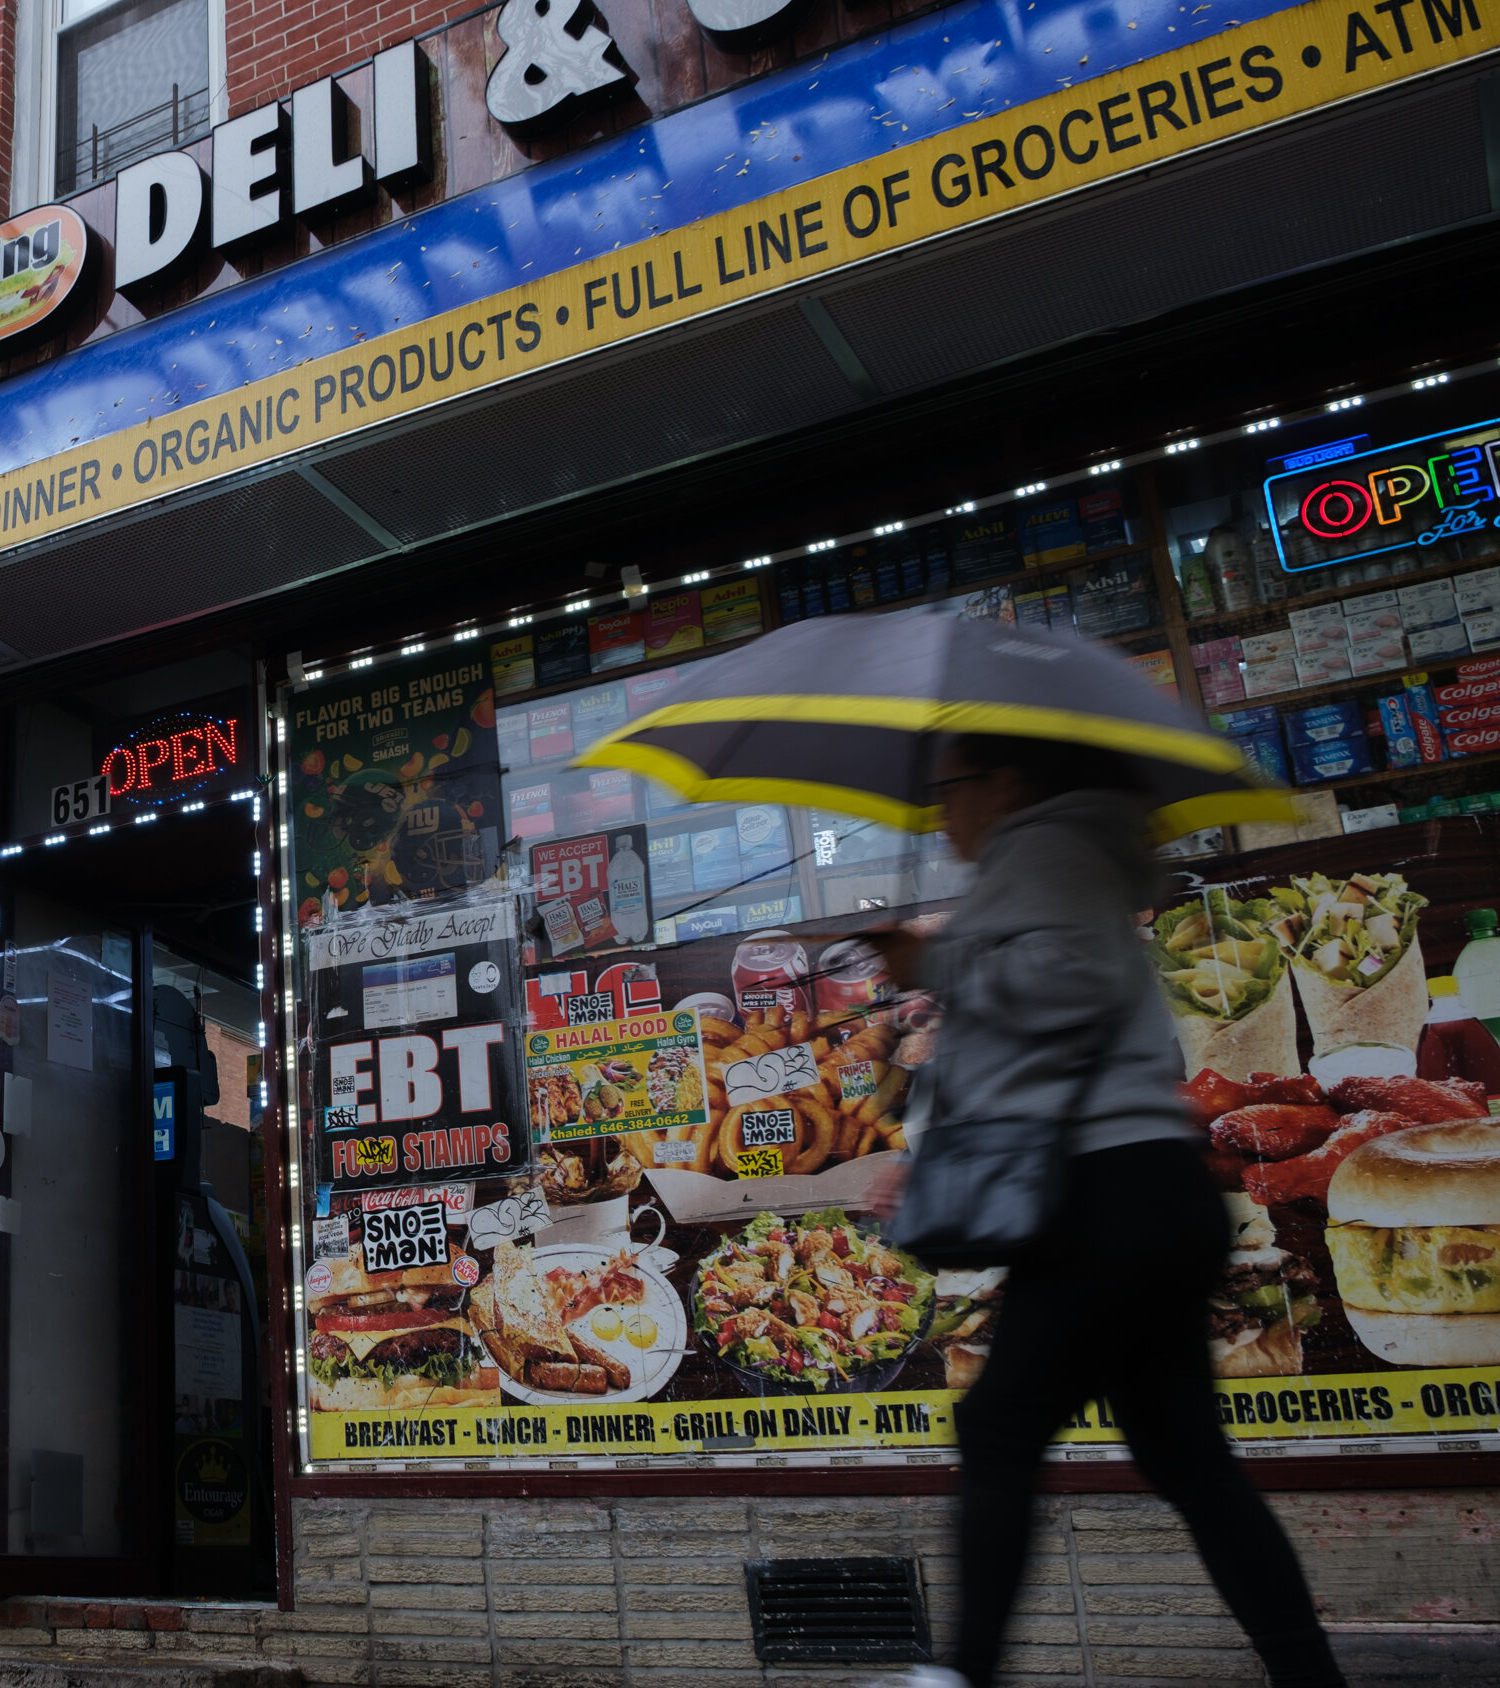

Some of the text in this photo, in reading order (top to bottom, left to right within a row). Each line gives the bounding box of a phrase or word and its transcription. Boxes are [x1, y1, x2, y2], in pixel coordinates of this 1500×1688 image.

[113, 0, 633, 290] DELI &
[132, 387, 301, 484] ORGANIC
[313, 302, 542, 424] PRODUCTS
[583, 251, 703, 331] FULL
[715, 200, 829, 287] LINE
[842, 169, 912, 239] OF
[930, 44, 1285, 209] GROCERIES
[1343, 0, 1484, 74] ATM
[1286, 446, 1353, 470] BUD LIGHT
[1301, 441, 1500, 538] OPE
[961, 521, 1005, 541] Advil
[1082, 571, 1129, 593] Advil
[711, 585, 747, 603] Advil
[651, 595, 690, 614] Pepto
[598, 616, 631, 632] DayQuil
[493, 643, 523, 659] Advil
[1459, 658, 1500, 674] Colgat
[296, 662, 484, 728] FLAVOR BIG ENOUGH
[1439, 680, 1500, 700] Colga
[316, 688, 465, 743] FOR TWO TEAMS
[1445, 704, 1500, 723] Colga
[1419, 719, 1437, 761] Colgate
[1453, 730, 1500, 747] Colg
[102, 718, 238, 796] OPEN
[372, 743, 410, 762] SMASH
[53, 776, 108, 826] 651
[538, 840, 602, 862] WE ACCEPT
[650, 838, 674, 851] dvil
[540, 853, 604, 897] EBT
[745, 899, 785, 917] Advil
[328, 913, 497, 958] We Gladly Accept
[690, 918, 723, 933] NyQuil
[556, 1018, 668, 1049] HALAL FOOD
[656, 1035, 696, 1047] Halal Gyro
[528, 1053, 571, 1067] Halal Chicken
[329, 1023, 504, 1127] EBT
[838, 1062, 872, 1079] PRINCE
[843, 1083, 877, 1099] SOUND
[625, 1108, 652, 1118] DELIVERY
[630, 1099, 645, 1108] FREE
[549, 1113, 690, 1140] Khaled: 646-384-0642
[402, 1122, 511, 1172] STAMPS
[454, 1260, 478, 1280] ALPHA
[454, 1265, 478, 1283] RALPH
[345, 1378, 1500, 1448] BREAKFAST LUNCH DINNER GRILL ON DAILY ATM GROCERIES ORG
[184, 1480, 244, 1508] Entourage
